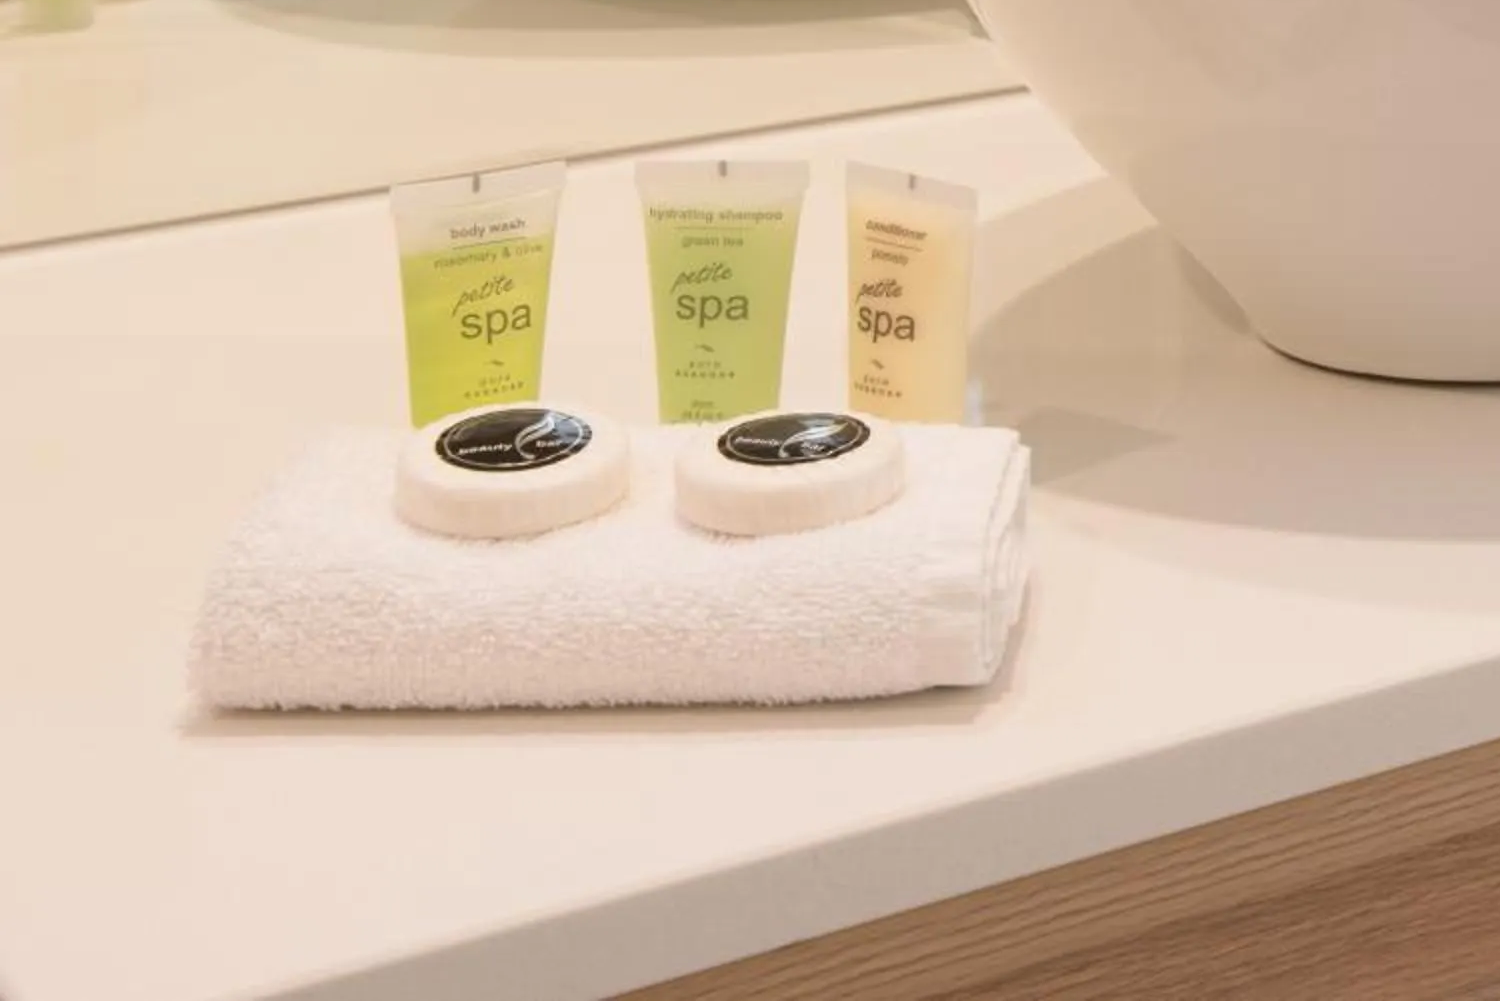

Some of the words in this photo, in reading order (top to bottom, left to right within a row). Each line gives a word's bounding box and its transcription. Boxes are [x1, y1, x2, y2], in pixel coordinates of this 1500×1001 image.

[450, 222, 486, 240] body
[489, 218, 526, 234] wash
[719, 208, 783, 225] shampoo
[671, 262, 733, 295] petite
[856, 279, 903, 303] petite
[452, 274, 515, 318] petite
[676, 294, 750, 328] spa
[460, 303, 532, 345] spa
[857, 305, 916, 343] spa
